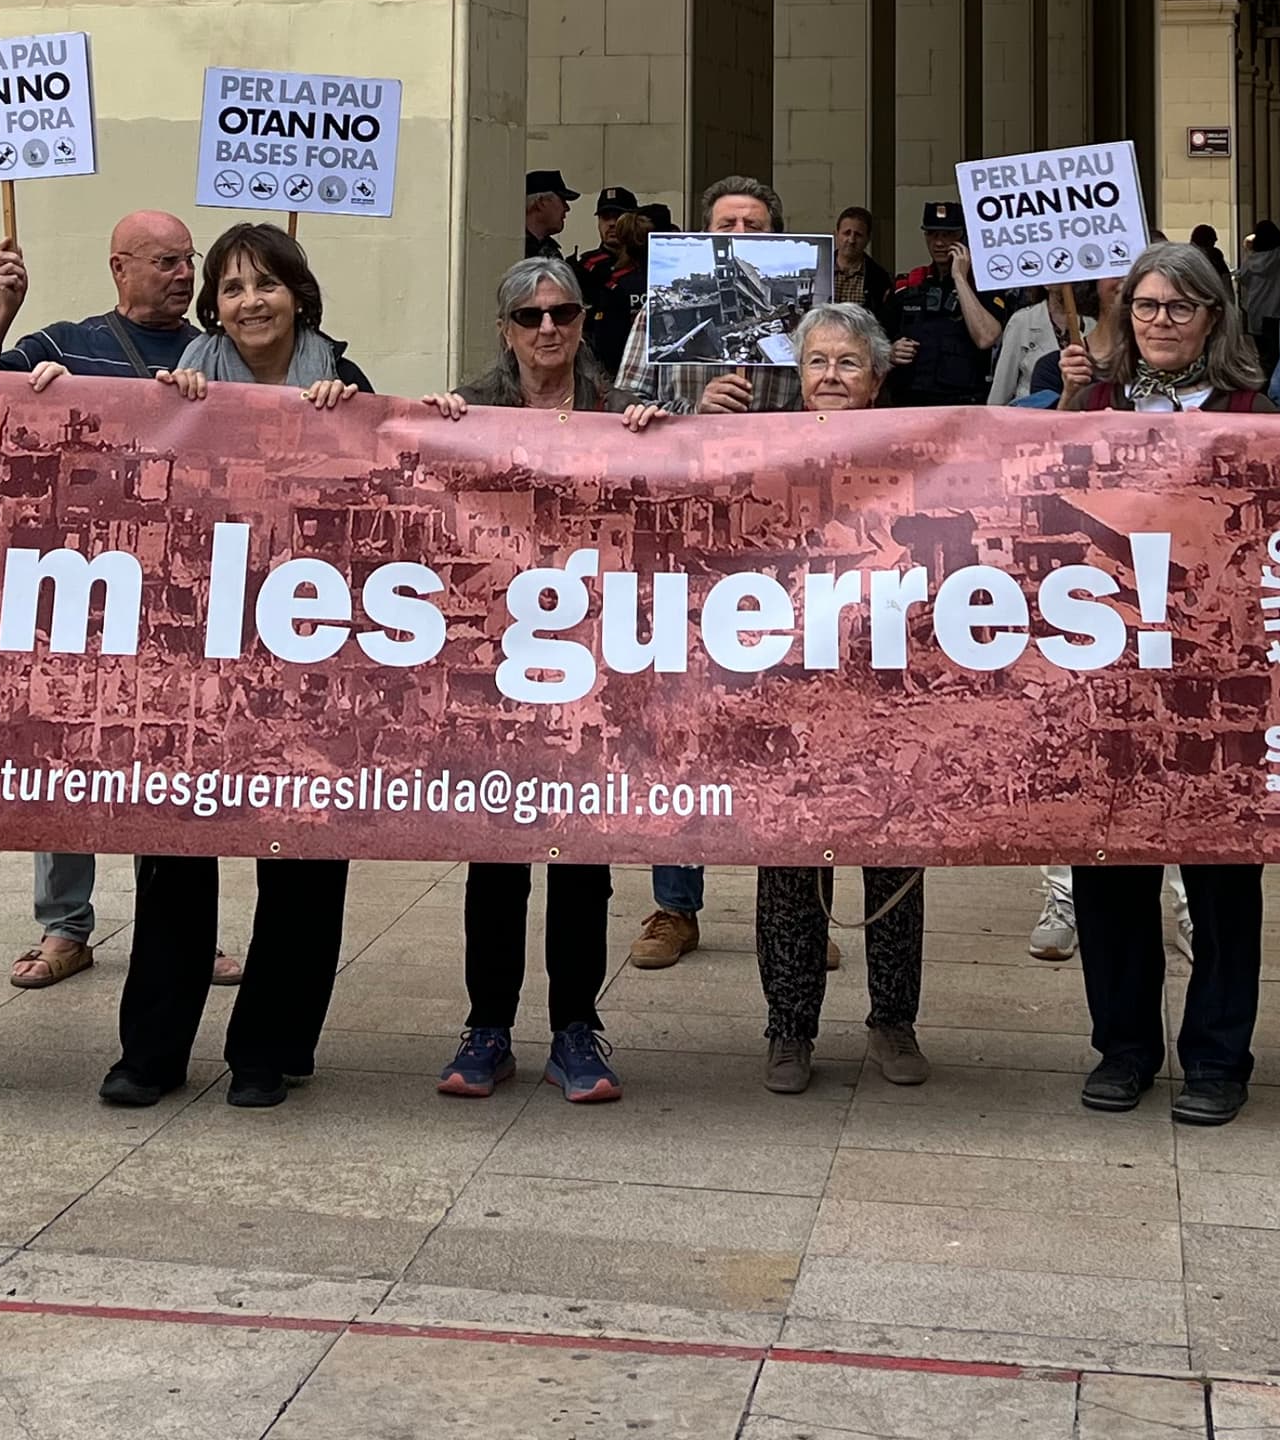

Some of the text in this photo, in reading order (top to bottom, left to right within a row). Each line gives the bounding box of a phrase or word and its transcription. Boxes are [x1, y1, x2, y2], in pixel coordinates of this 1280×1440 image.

[11, 39, 68, 69] PAU
[16, 71, 71, 104] NO
[220, 75, 383, 109] PER LA PAU
[6, 106, 75, 134] FORA
[218, 106, 380, 143] OTAN NO
[215, 140, 379, 171] BASES FORA
[971, 151, 1115, 192] PER LA PAU
[976, 181, 1120, 222] OTAN NO
[980, 212, 1127, 249] BASES FORA
[203, 521, 448, 668] les
[493, 530, 1174, 705] guerres!
